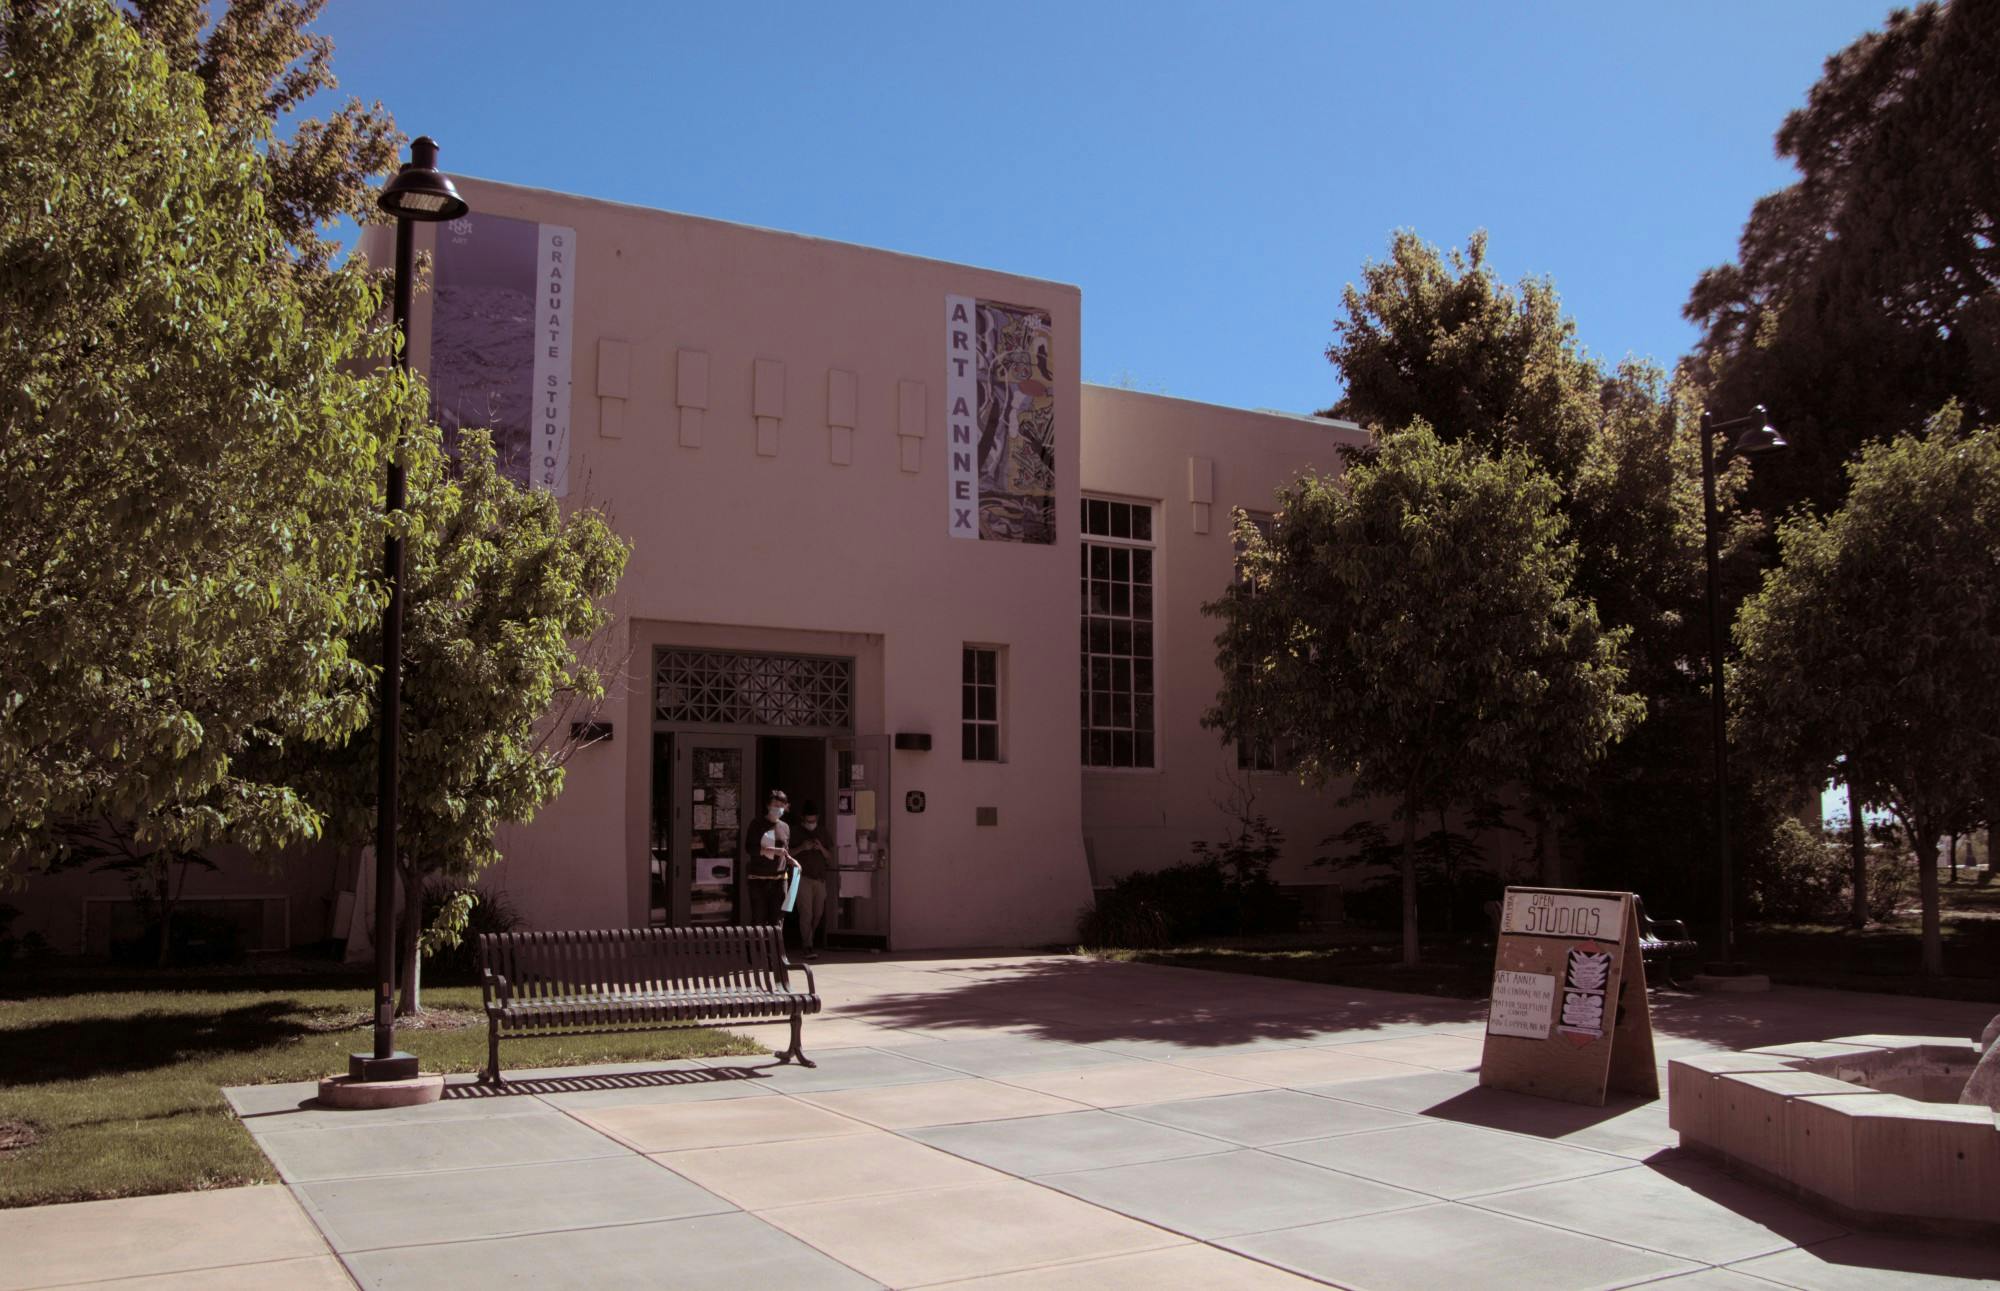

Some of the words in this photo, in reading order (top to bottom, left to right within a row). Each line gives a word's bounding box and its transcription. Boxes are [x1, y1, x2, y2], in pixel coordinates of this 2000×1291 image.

[547, 235, 564, 358] GRADUATE
[952, 304, 969, 377] ART
[543, 375, 558, 485] STUDIOS
[952, 397, 972, 529] ANNEX
[1525, 906, 1600, 936] STUDIOS
[1532, 895, 1555, 907] OPEN
[1494, 971, 1509, 984] ART
[1513, 974, 1537, 986] ANNEX
